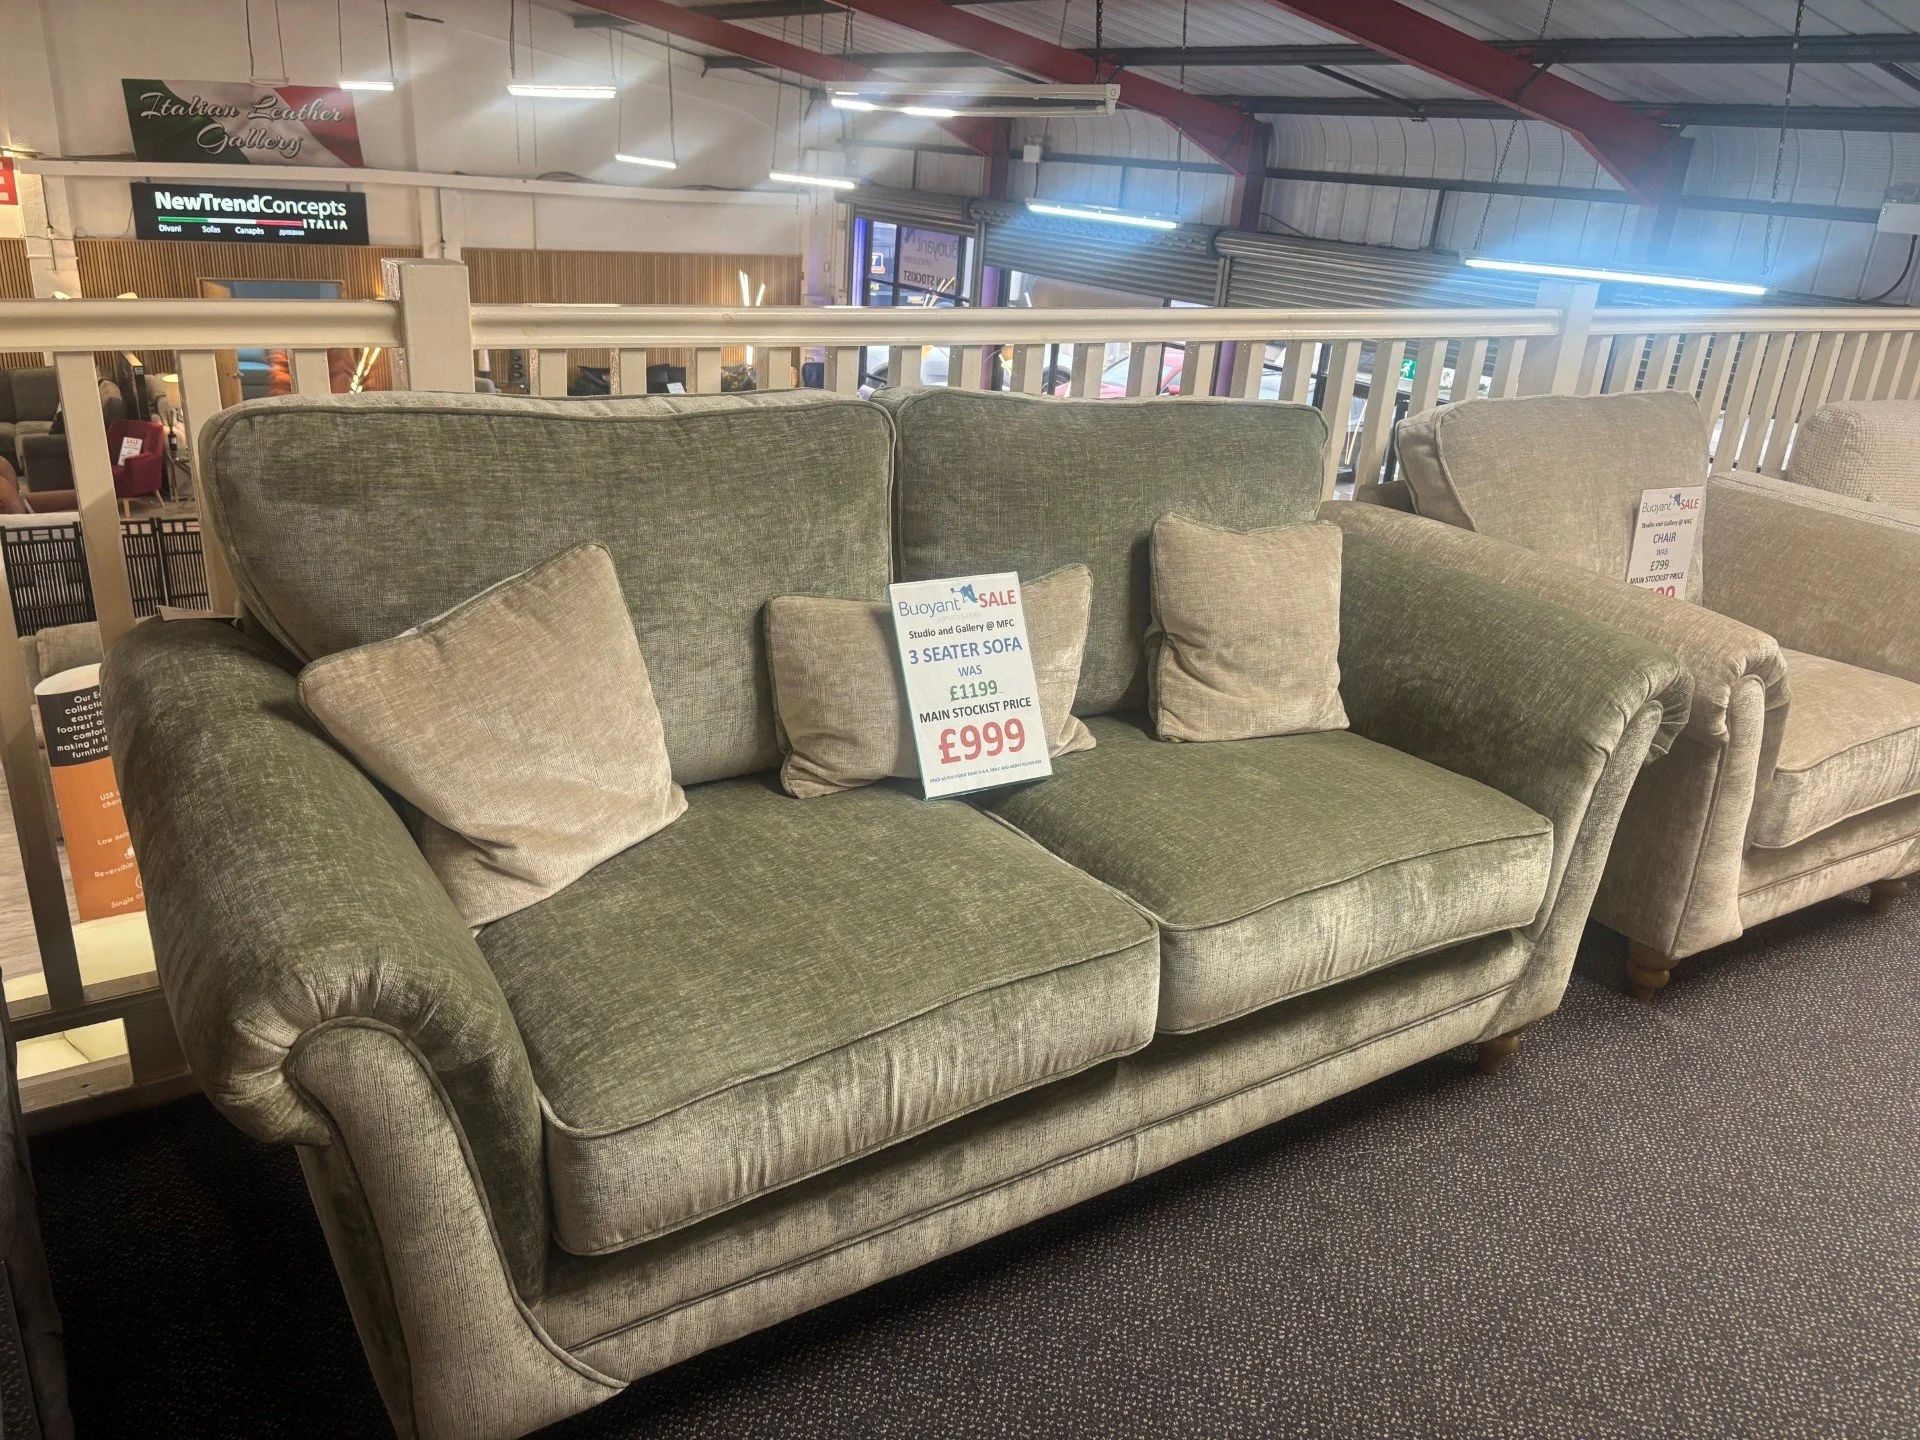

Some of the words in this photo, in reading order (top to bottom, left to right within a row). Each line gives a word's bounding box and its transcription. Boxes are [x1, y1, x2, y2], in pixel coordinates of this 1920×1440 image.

[140, 91, 239, 119] Italian
[248, 94, 345, 122] Leather
[197, 123, 303, 158] Gallery
[155, 191, 347, 219] NewTrendConcepts
[158, 224, 182, 233] Divani
[202, 226, 221, 234] Sofas
[303, 219, 348, 230] ITALIA
[1642, 502, 1671, 514] Buoyant
[1680, 499, 1699, 510] SALE
[1653, 532, 1676, 544] CHAIR
[1650, 560, 1669, 571] £799
[1645, 574, 1668, 582] STOCKIST
[899, 597, 961, 618] Buoyant
[979, 589, 1016, 608] SALE
[909, 629, 936, 639] Studio
[938, 626, 953, 636] and
[955, 622, 984, 634] Gallery
[986, 621, 995, 631] @
[996, 619, 1014, 628] MFC
[909, 649, 919, 664] 3
[924, 642, 979, 663] SEATER
[984, 636, 1022, 653] SOFA
[958, 665, 982, 677] WAS
[950, 680, 998, 701] £1199
[920, 710, 950, 724] MAIN
[952, 702, 1001, 719] STOCKIST
[1003, 697, 1031, 710] PRICE
[57, 722, 93, 733] footrest
[57, 742, 89, 751] making
[939, 718, 1025, 764] £999
[95, 862, 133, 878] Reversible
[111, 897, 134, 908] Single
